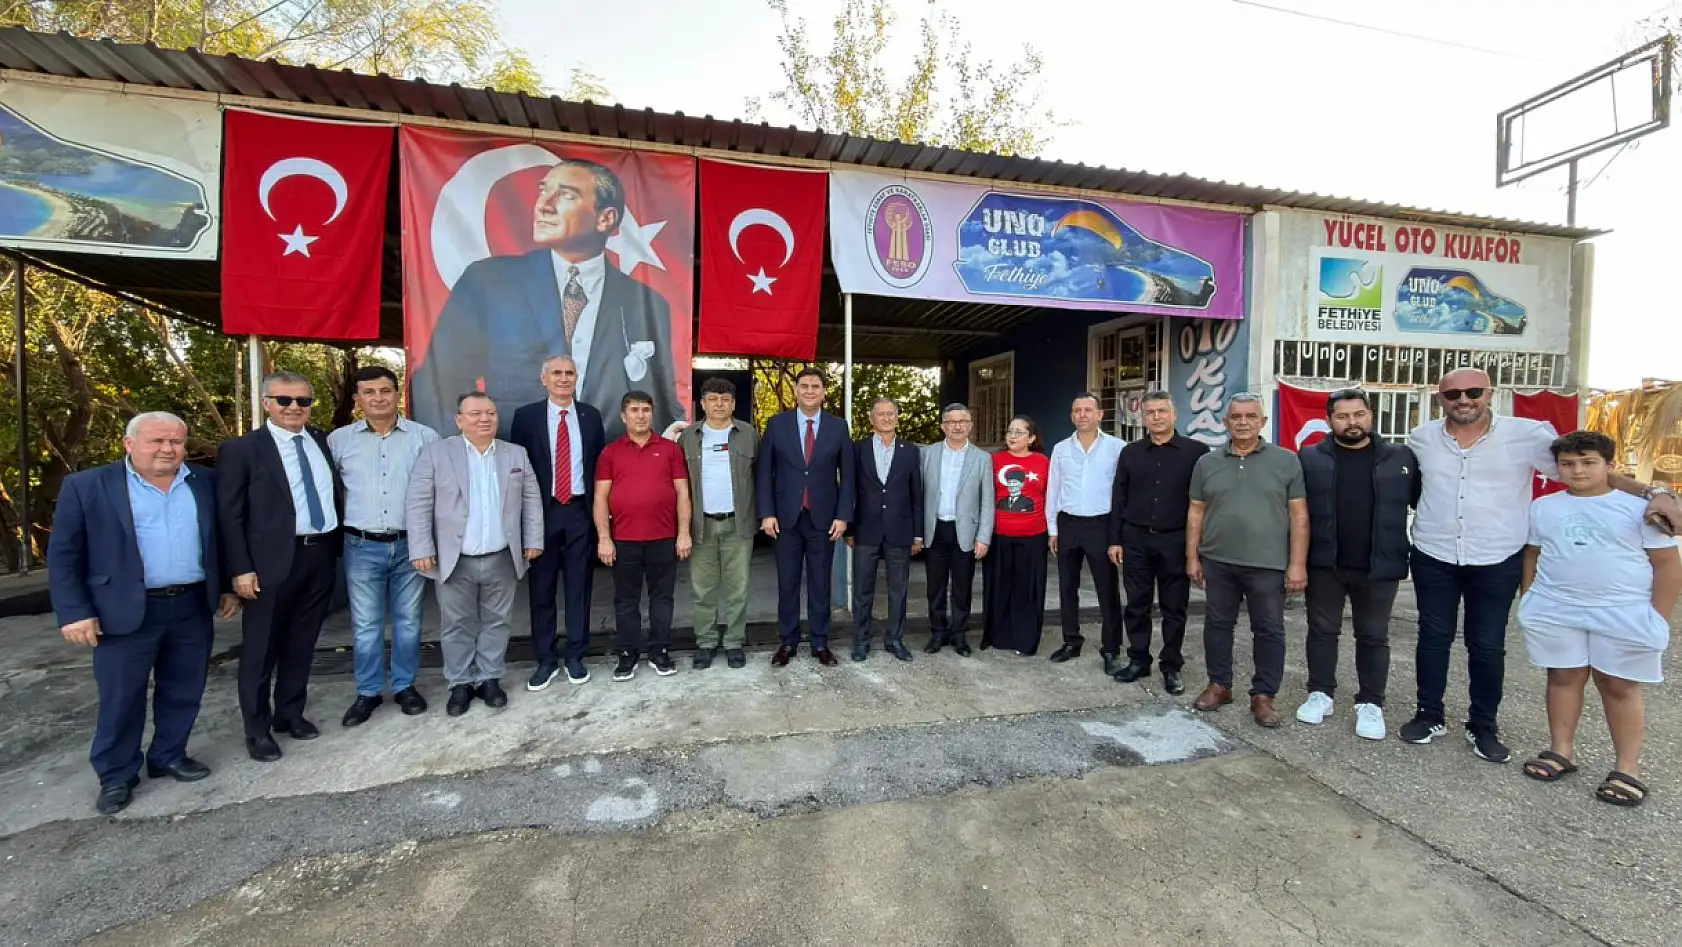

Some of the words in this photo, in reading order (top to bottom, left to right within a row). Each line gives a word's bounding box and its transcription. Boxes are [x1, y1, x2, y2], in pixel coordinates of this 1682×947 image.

[983, 208, 1045, 237] UNO
[988, 237, 1041, 258] CLUB
[1323, 215, 1386, 252] YÜCEL
[1395, 226, 1436, 254] OTO
[1444, 232, 1521, 264] KUAFÖR
[984, 263, 1049, 290] Fethiye
[1409, 277, 1439, 294] UNO
[1368, 348, 1424, 363] CLUP
